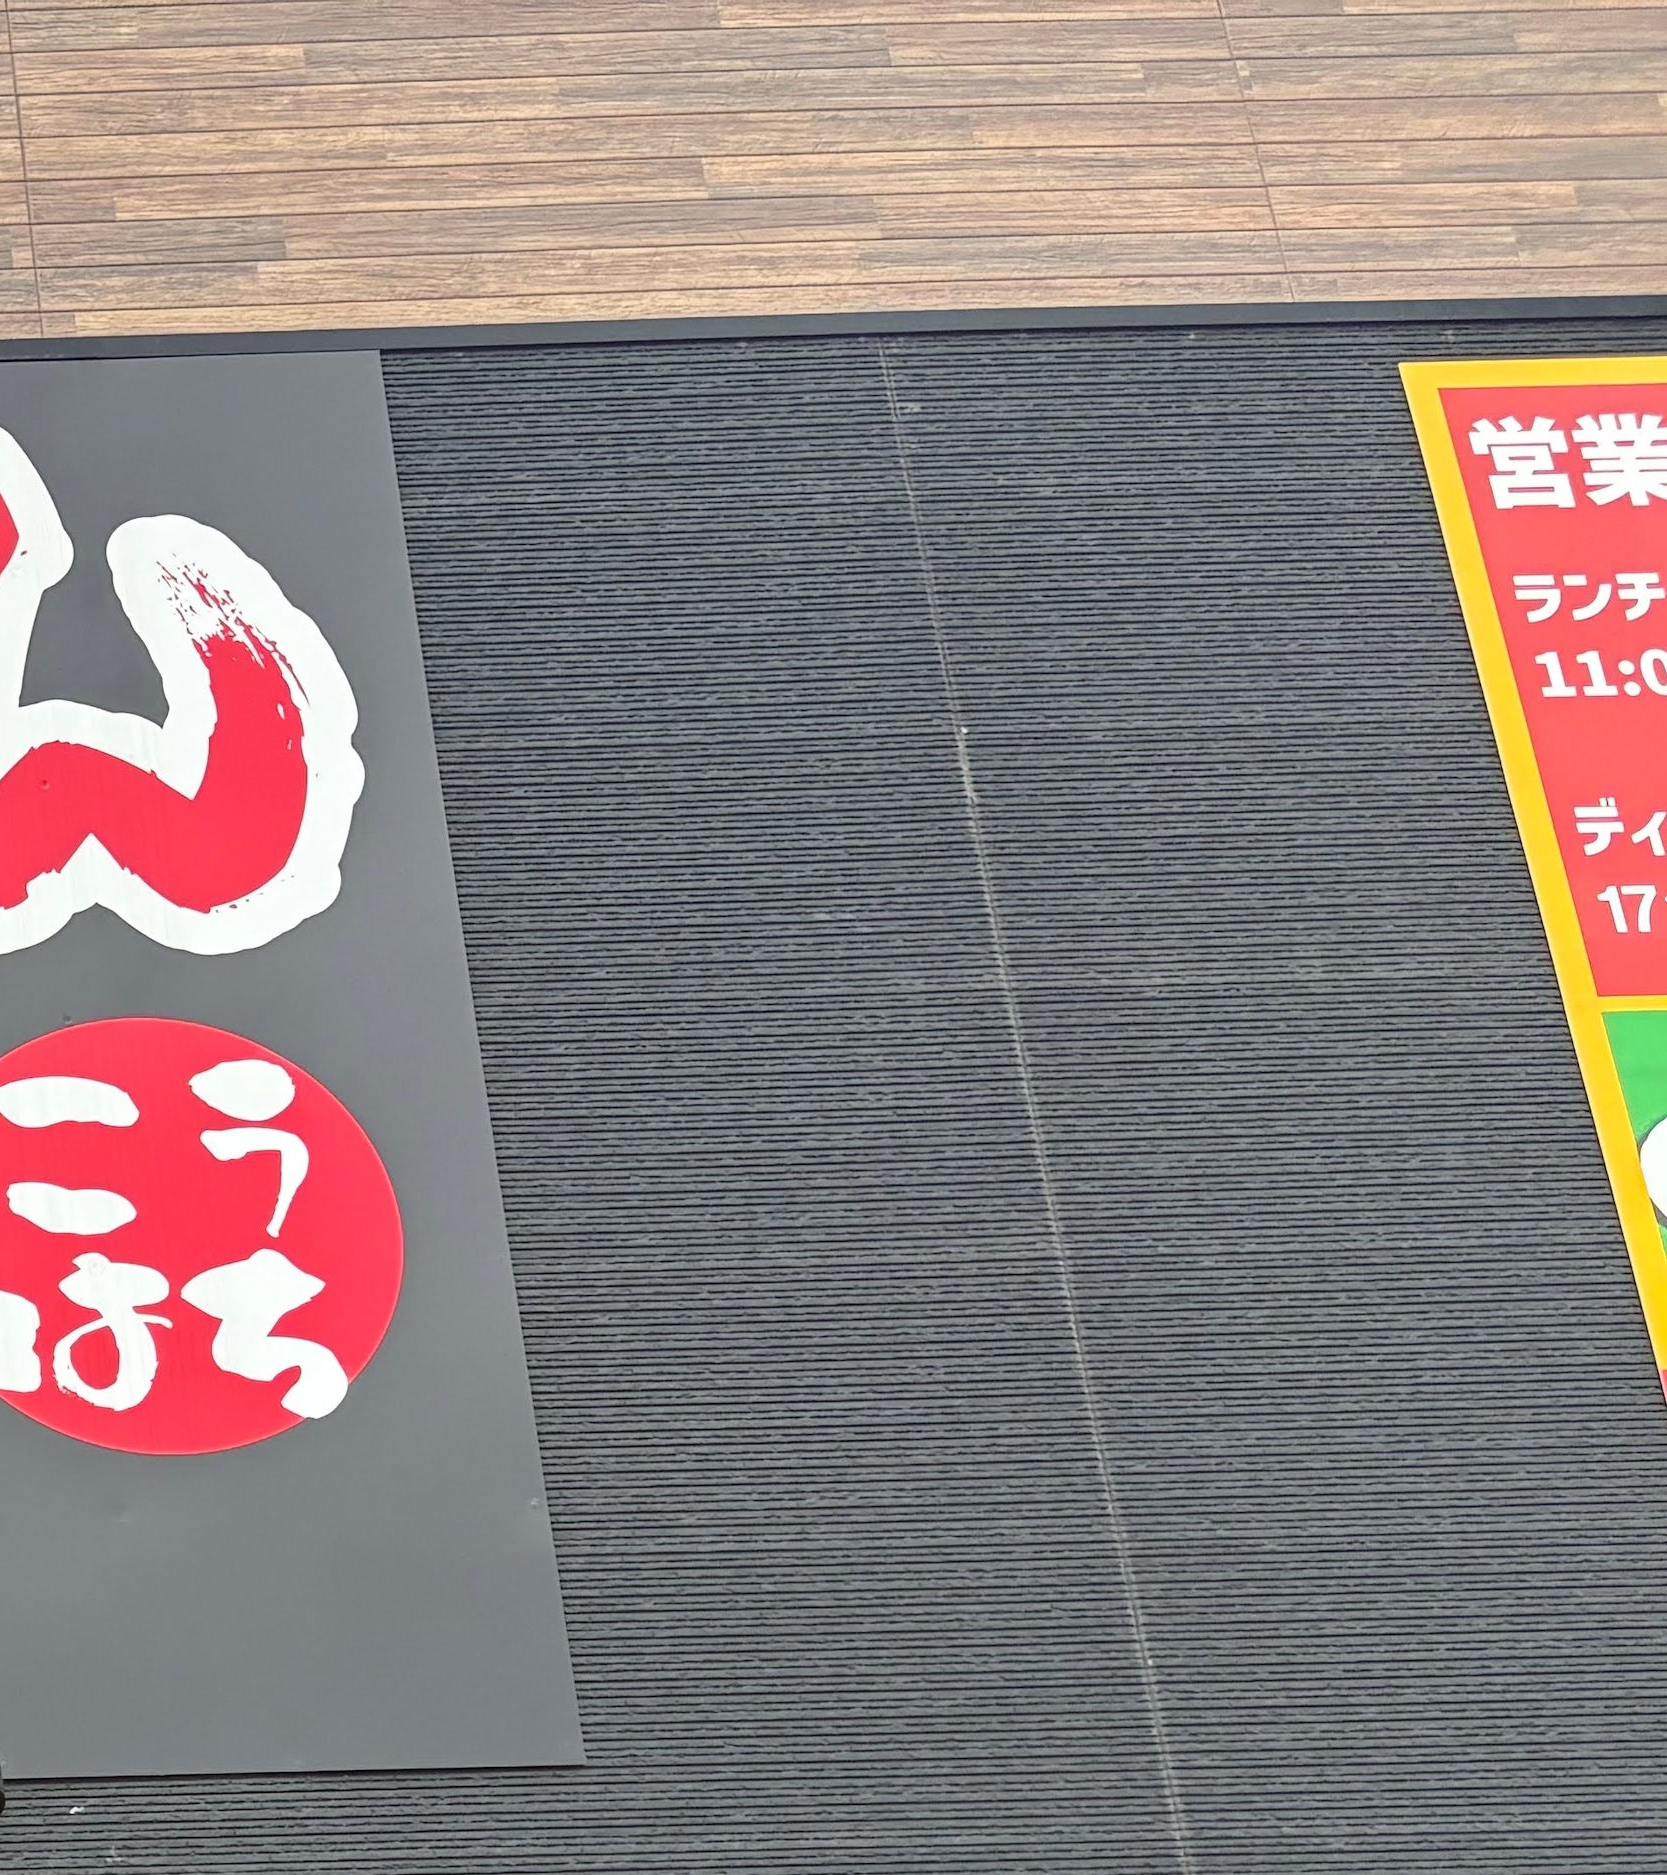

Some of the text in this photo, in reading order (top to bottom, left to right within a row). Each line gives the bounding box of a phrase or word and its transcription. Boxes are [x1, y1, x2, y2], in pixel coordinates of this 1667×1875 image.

[1512, 571, 1666, 624] ランチ
[1596, 884, 1667, 934] 17
